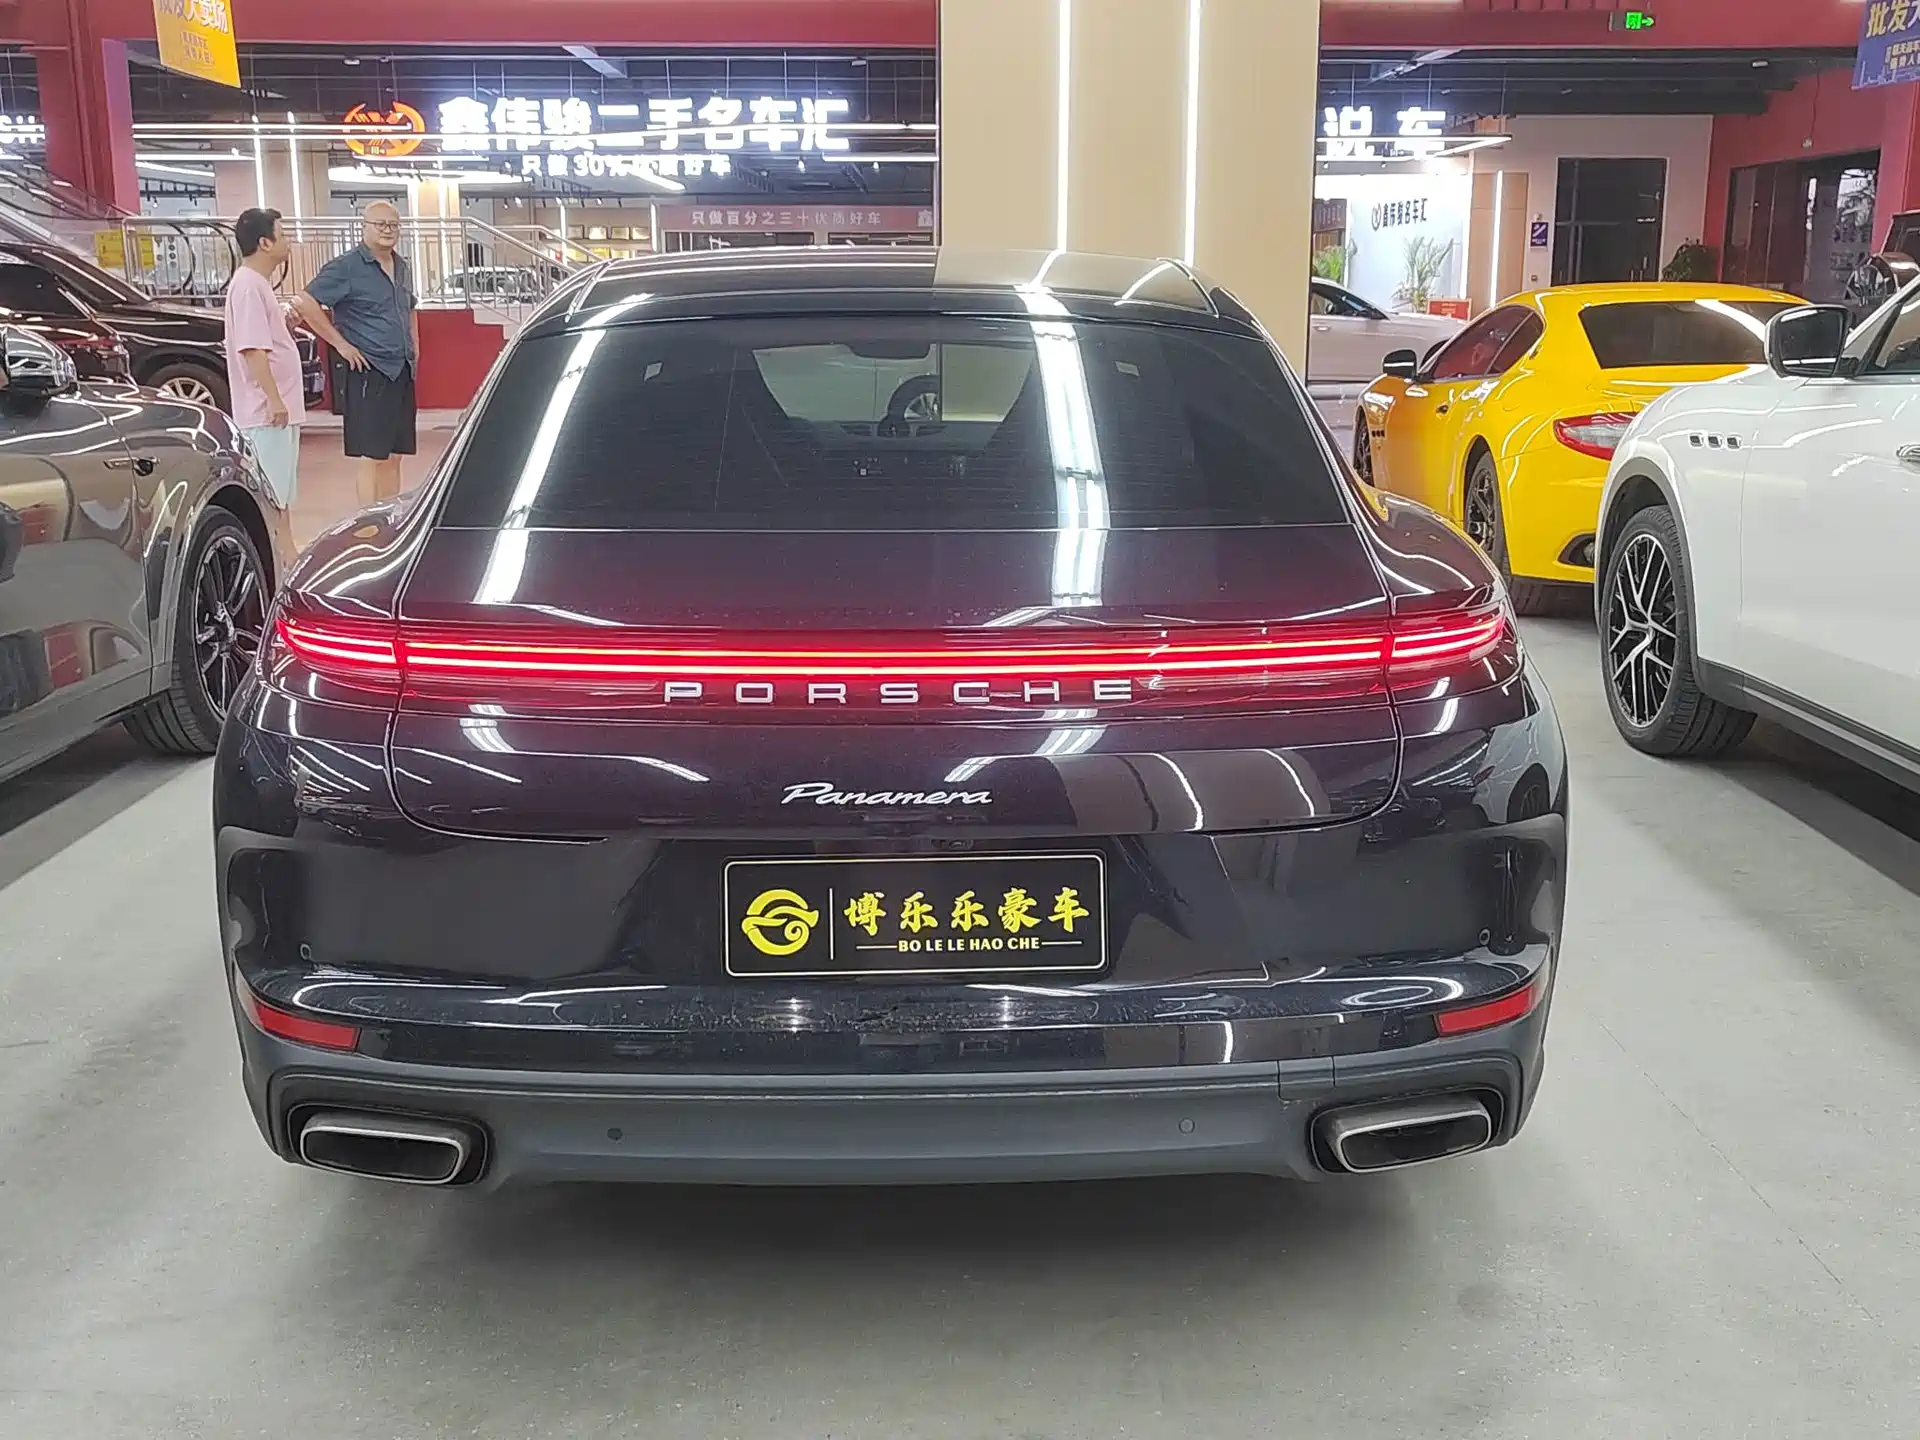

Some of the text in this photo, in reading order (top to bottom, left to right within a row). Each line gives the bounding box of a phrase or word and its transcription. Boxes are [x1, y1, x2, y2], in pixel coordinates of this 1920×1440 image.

[663, 680, 1132, 704] PORSCHE
[781, 782, 993, 805] Panamera
[844, 886, 1090, 936] 博乐乐豪车
[898, 937, 1040, 952] BO LE LE HAO CHE
